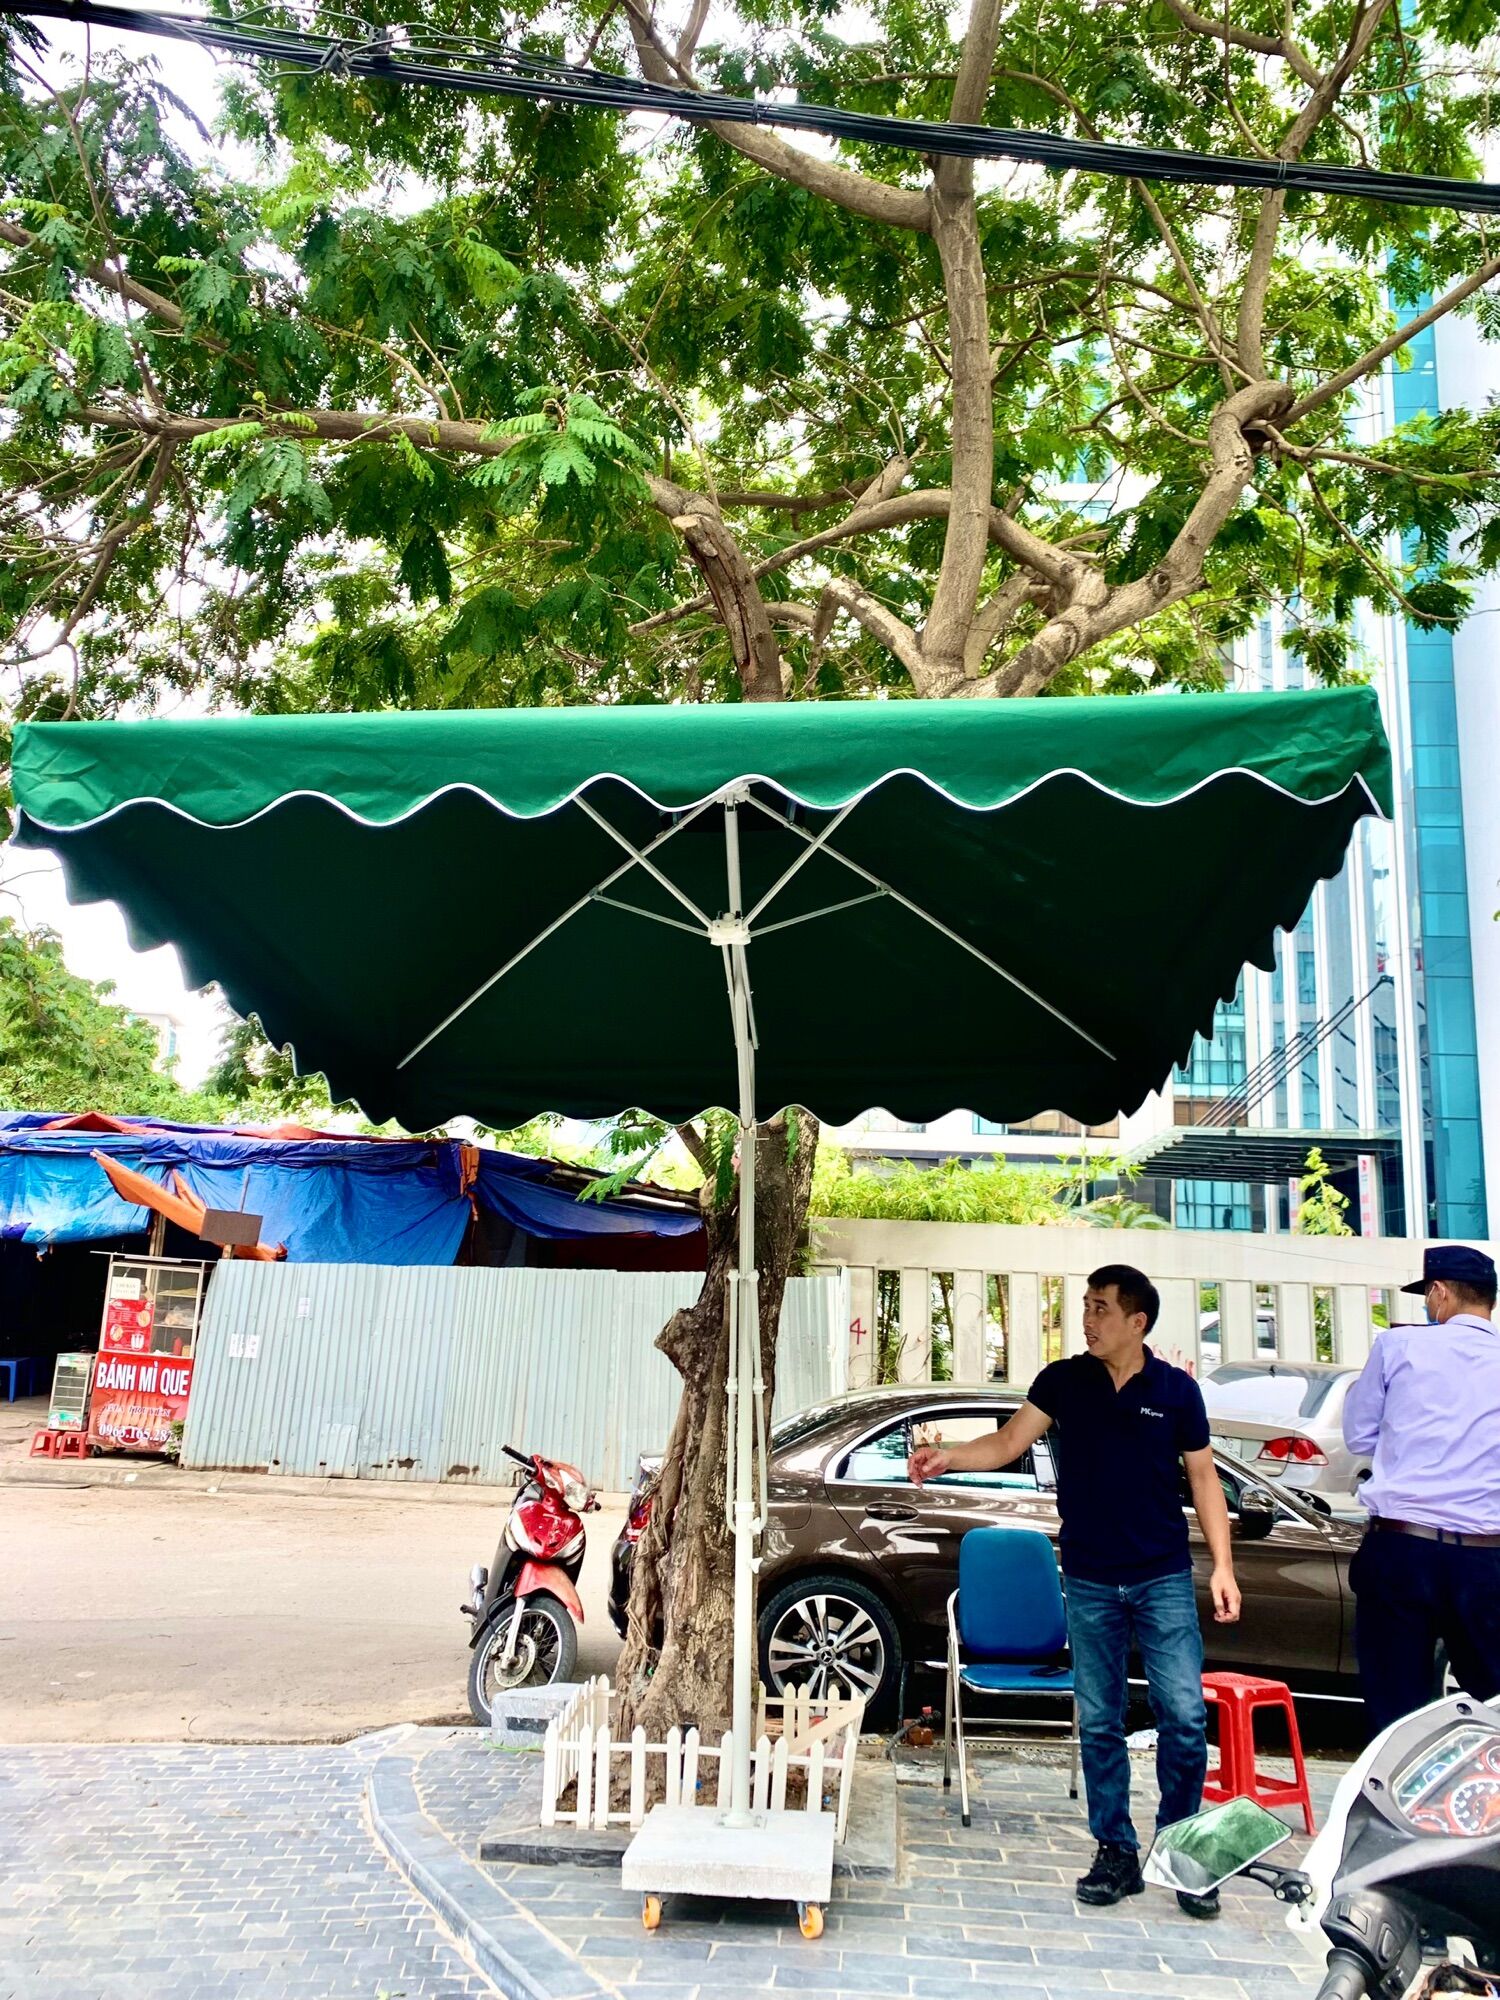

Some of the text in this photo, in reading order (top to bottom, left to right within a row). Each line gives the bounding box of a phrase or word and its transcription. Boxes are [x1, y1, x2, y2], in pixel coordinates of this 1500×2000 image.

[850, 1317, 867, 1345] 4
[96, 1357, 190, 1396] BÁNH MÌ QUE
